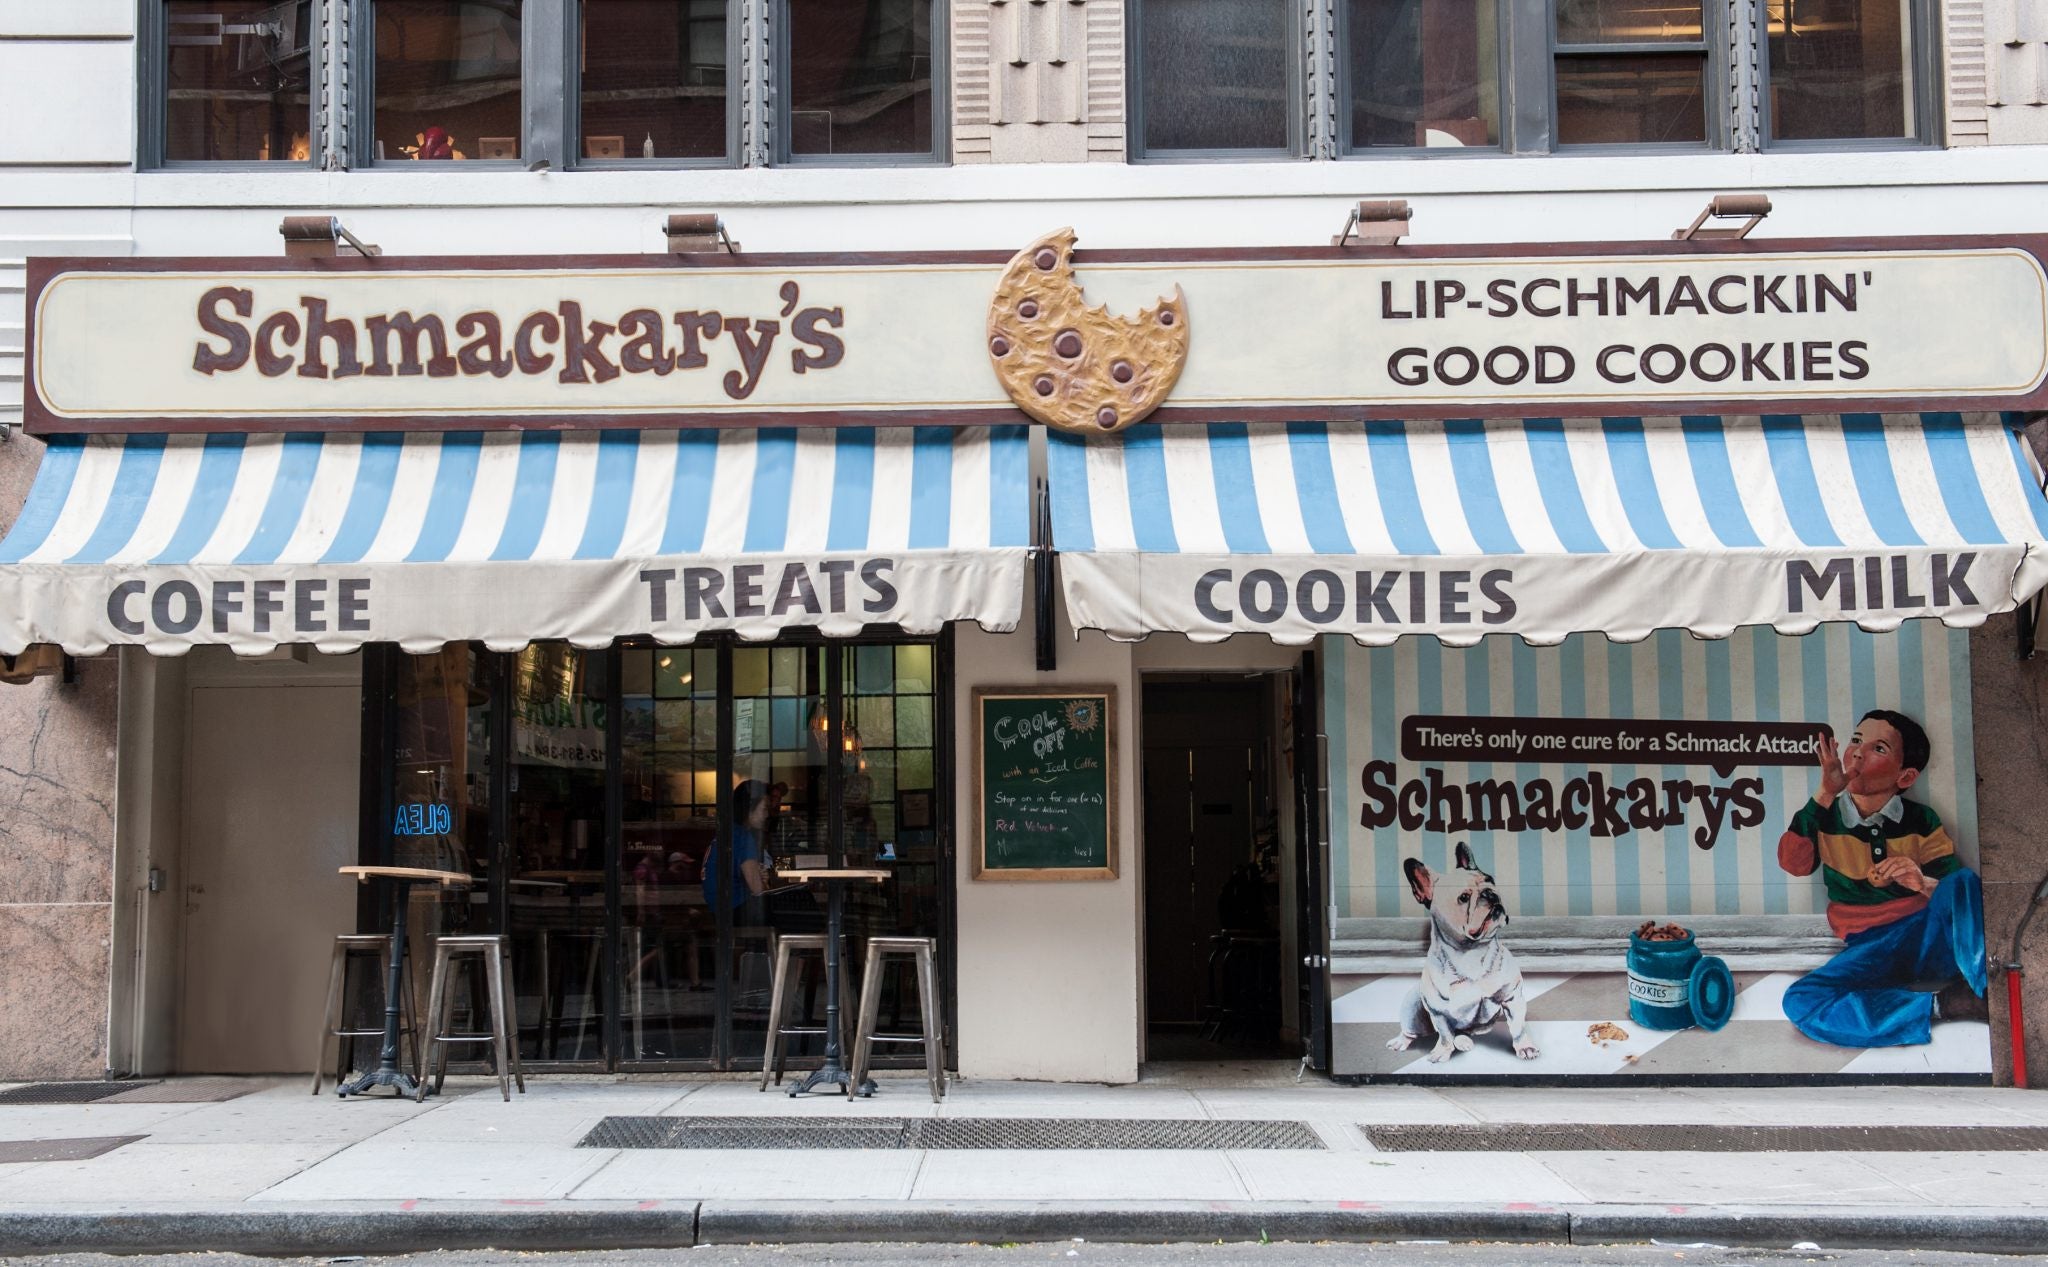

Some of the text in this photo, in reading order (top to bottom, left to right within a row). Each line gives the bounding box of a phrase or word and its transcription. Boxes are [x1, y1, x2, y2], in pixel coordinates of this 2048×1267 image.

[1381, 270, 1872, 319] LIP-SCHMACKIN'
[193, 280, 845, 400] Schmackary's
[1387, 340, 1870, 386] GOOD COOKIES
[640, 558, 900, 626] TREATS
[1195, 568, 1517, 625] COOKIES
[1786, 552, 1980, 613] MILK
[107, 579, 371, 635] COFFEE
[1416, 727, 1820, 754] There's only one cure for a Schmack Attack
[1044, 758, 1070, 773] Iced
[994, 791, 1017, 807] Stop
[1021, 795, 1032, 803] on
[1036, 794, 1045, 803] in
[1050, 791, 1062, 803] for
[996, 819, 1016, 832] Red
[1629, 981, 1667, 998] COOKIES
